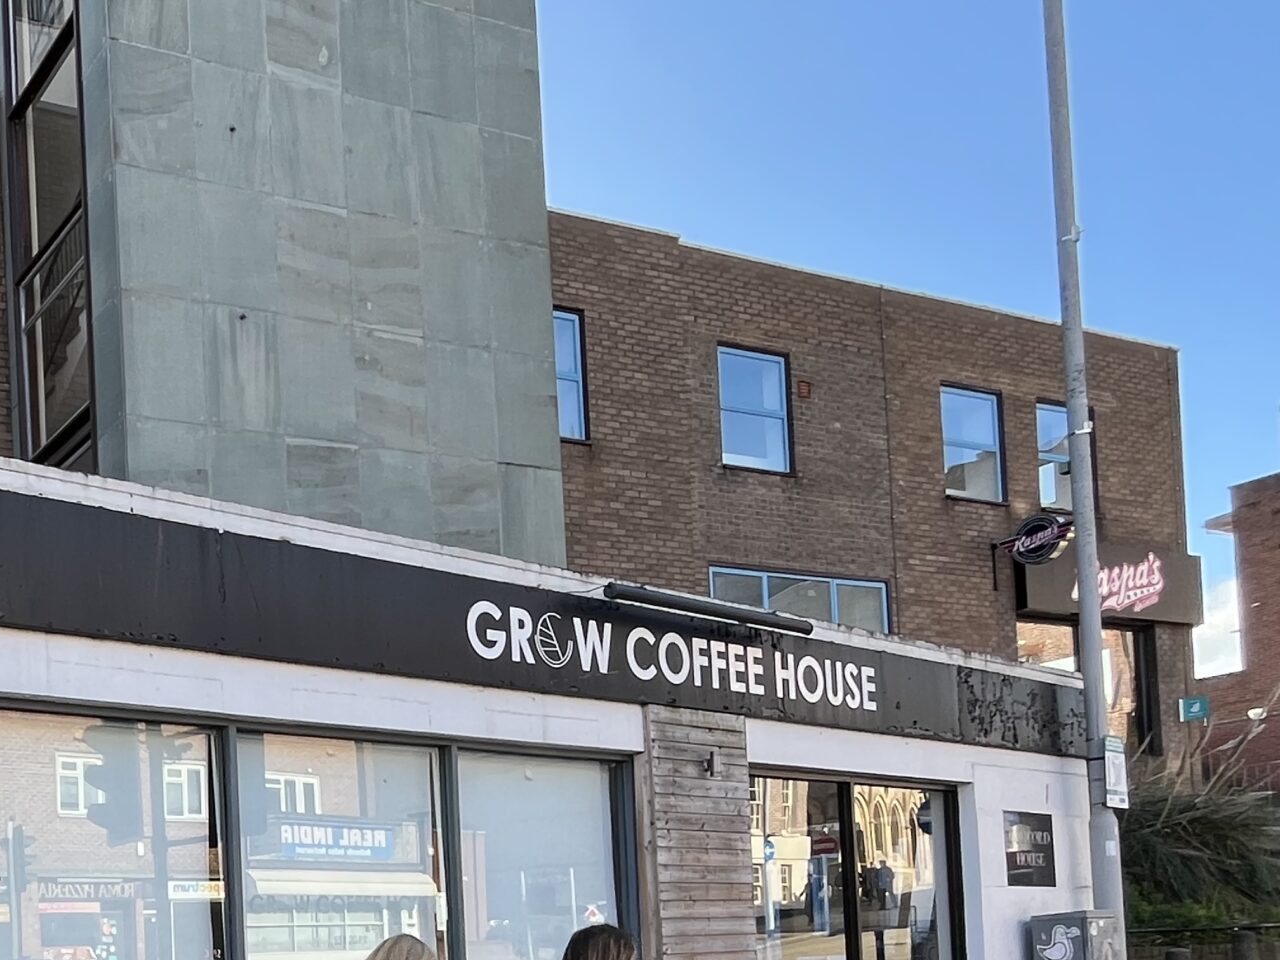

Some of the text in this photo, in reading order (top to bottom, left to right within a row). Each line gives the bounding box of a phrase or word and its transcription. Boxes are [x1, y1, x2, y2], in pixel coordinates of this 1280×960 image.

[1071, 551, 1164, 606] aspa's
[465, 600, 878, 711] GROW COFFEE HOUSE
